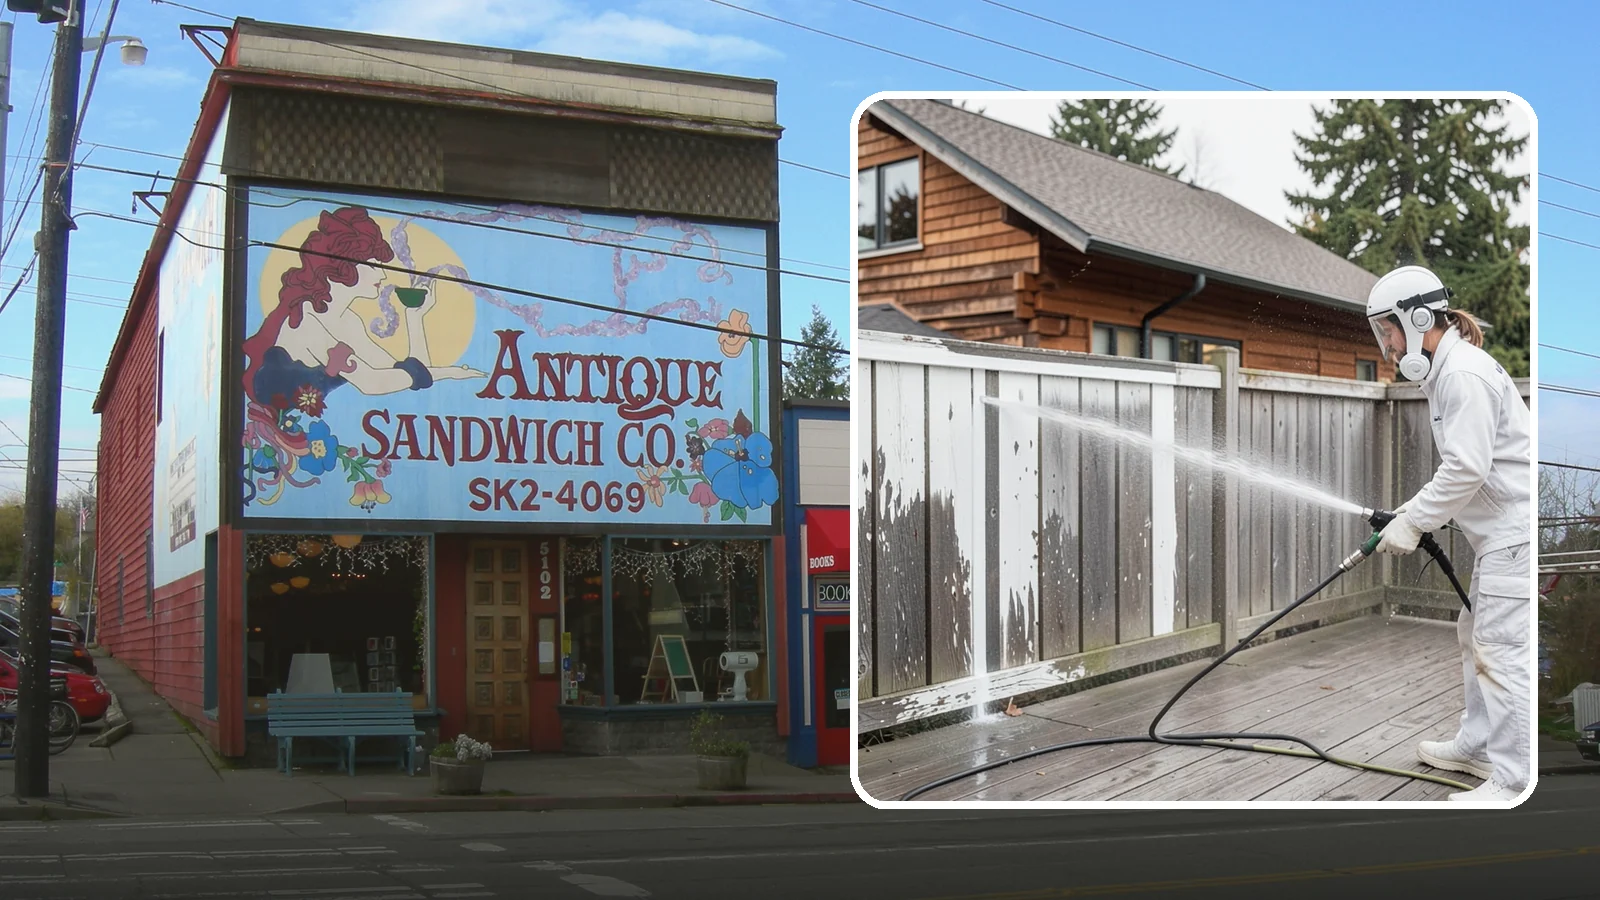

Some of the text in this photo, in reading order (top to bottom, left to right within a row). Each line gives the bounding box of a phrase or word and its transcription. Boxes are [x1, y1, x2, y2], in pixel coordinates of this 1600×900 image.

[361, 409, 685, 469] SANDWICH CO.
[468, 477, 646, 513] SK2-4069
[540, 541, 551, 600] 5102
[809, 555, 835, 569] BOOKS
